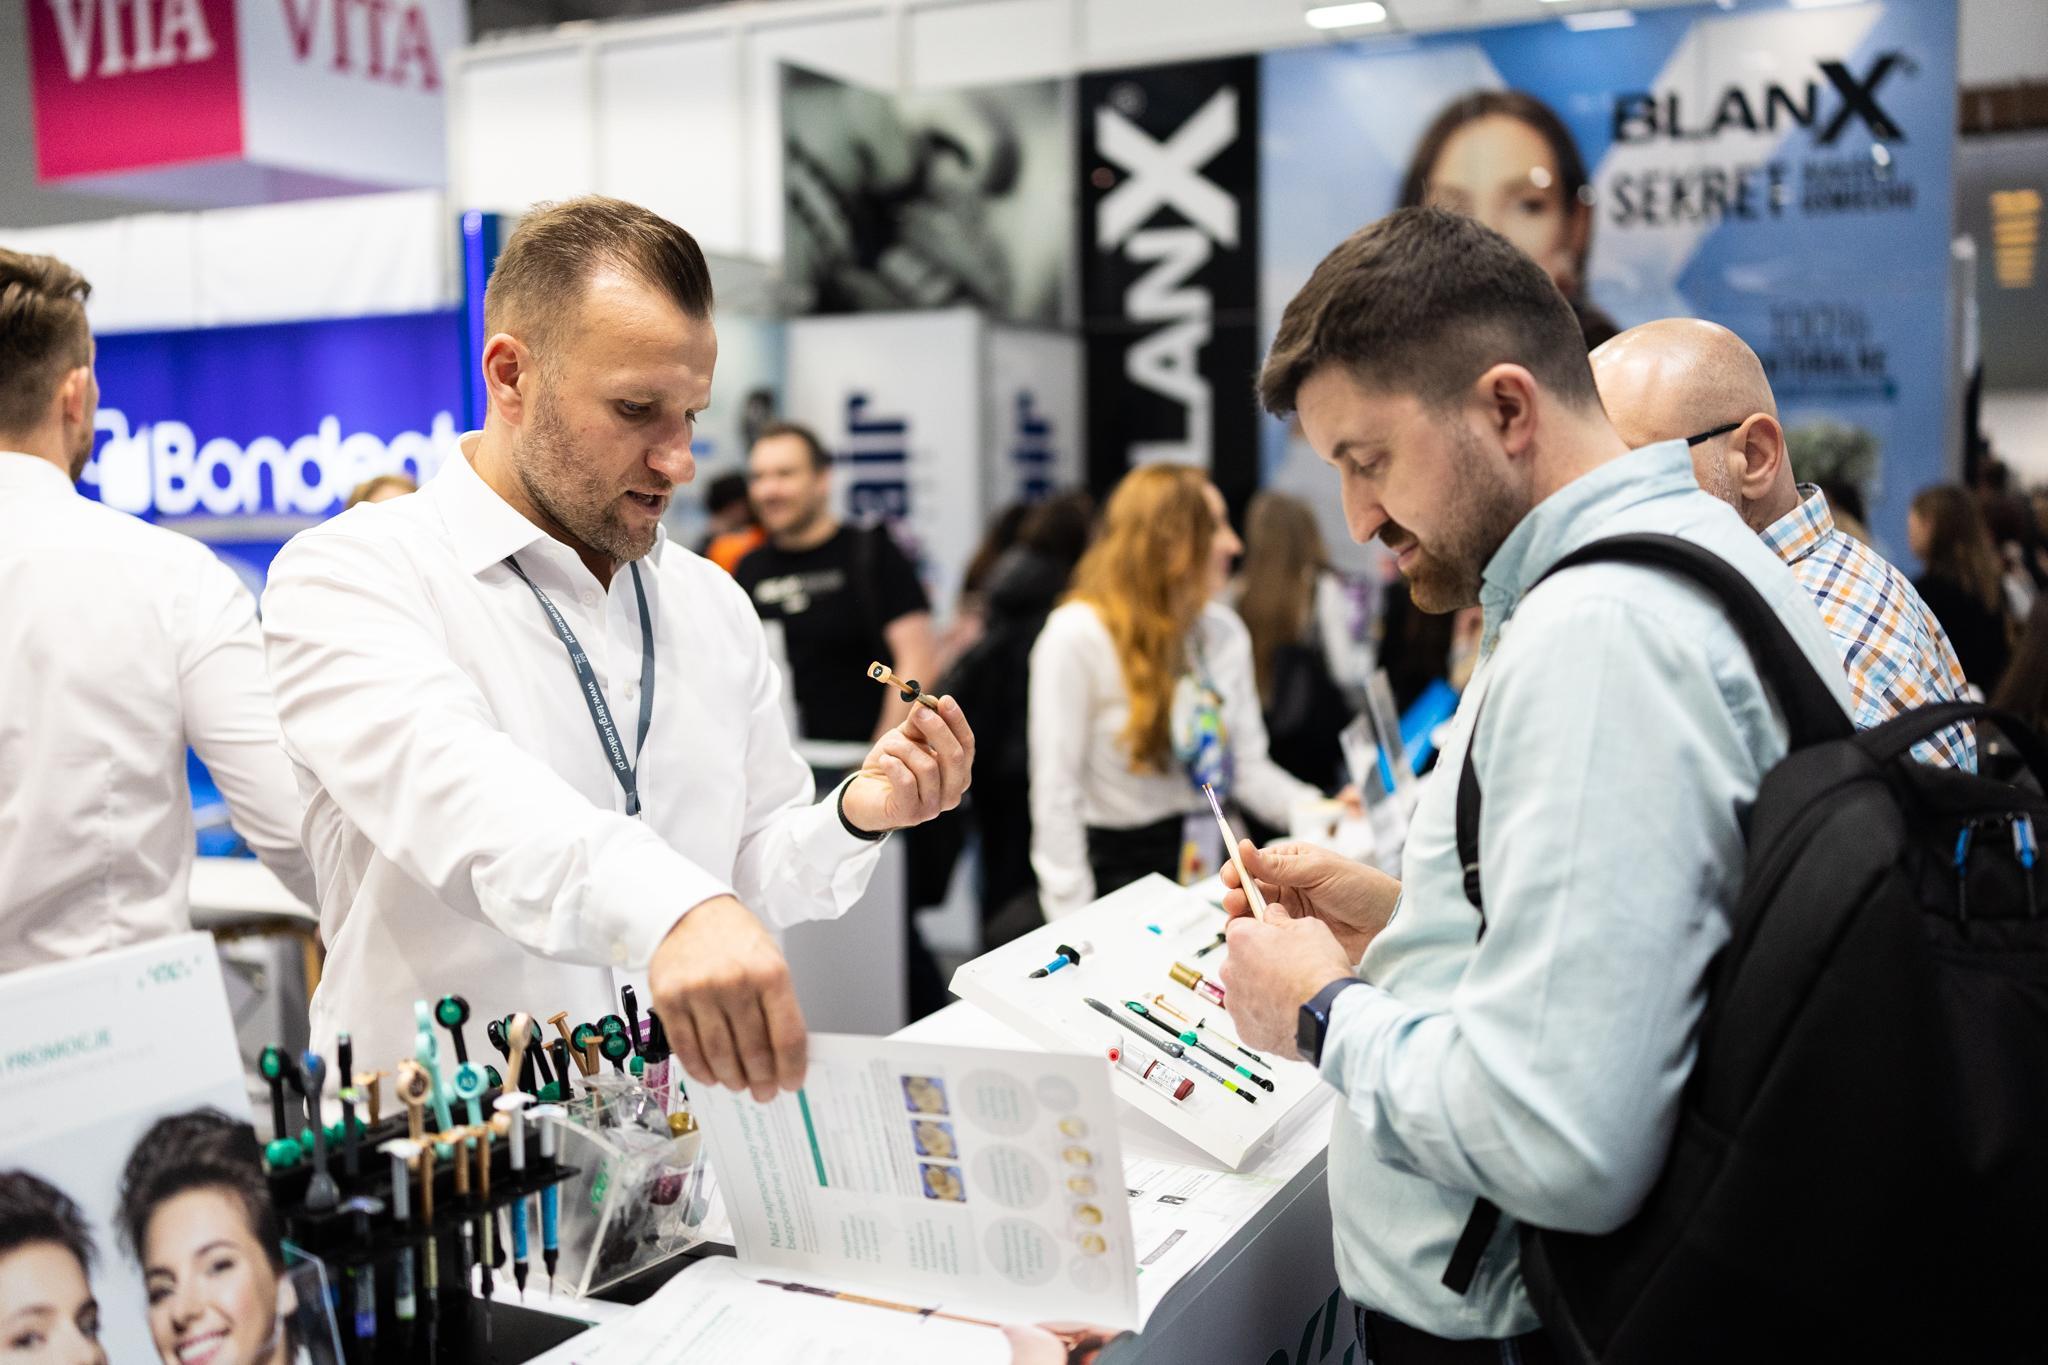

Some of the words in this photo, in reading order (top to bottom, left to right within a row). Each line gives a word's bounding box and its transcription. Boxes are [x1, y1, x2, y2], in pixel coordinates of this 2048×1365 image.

[282, 0, 442, 90] VITA
[1611, 53, 1906, 145] BLANX
[1611, 164, 1783, 227] SEKRET
[1096, 88, 1240, 466] LANX
[587, 681, 626, 771] www.targi.krakow.pl
